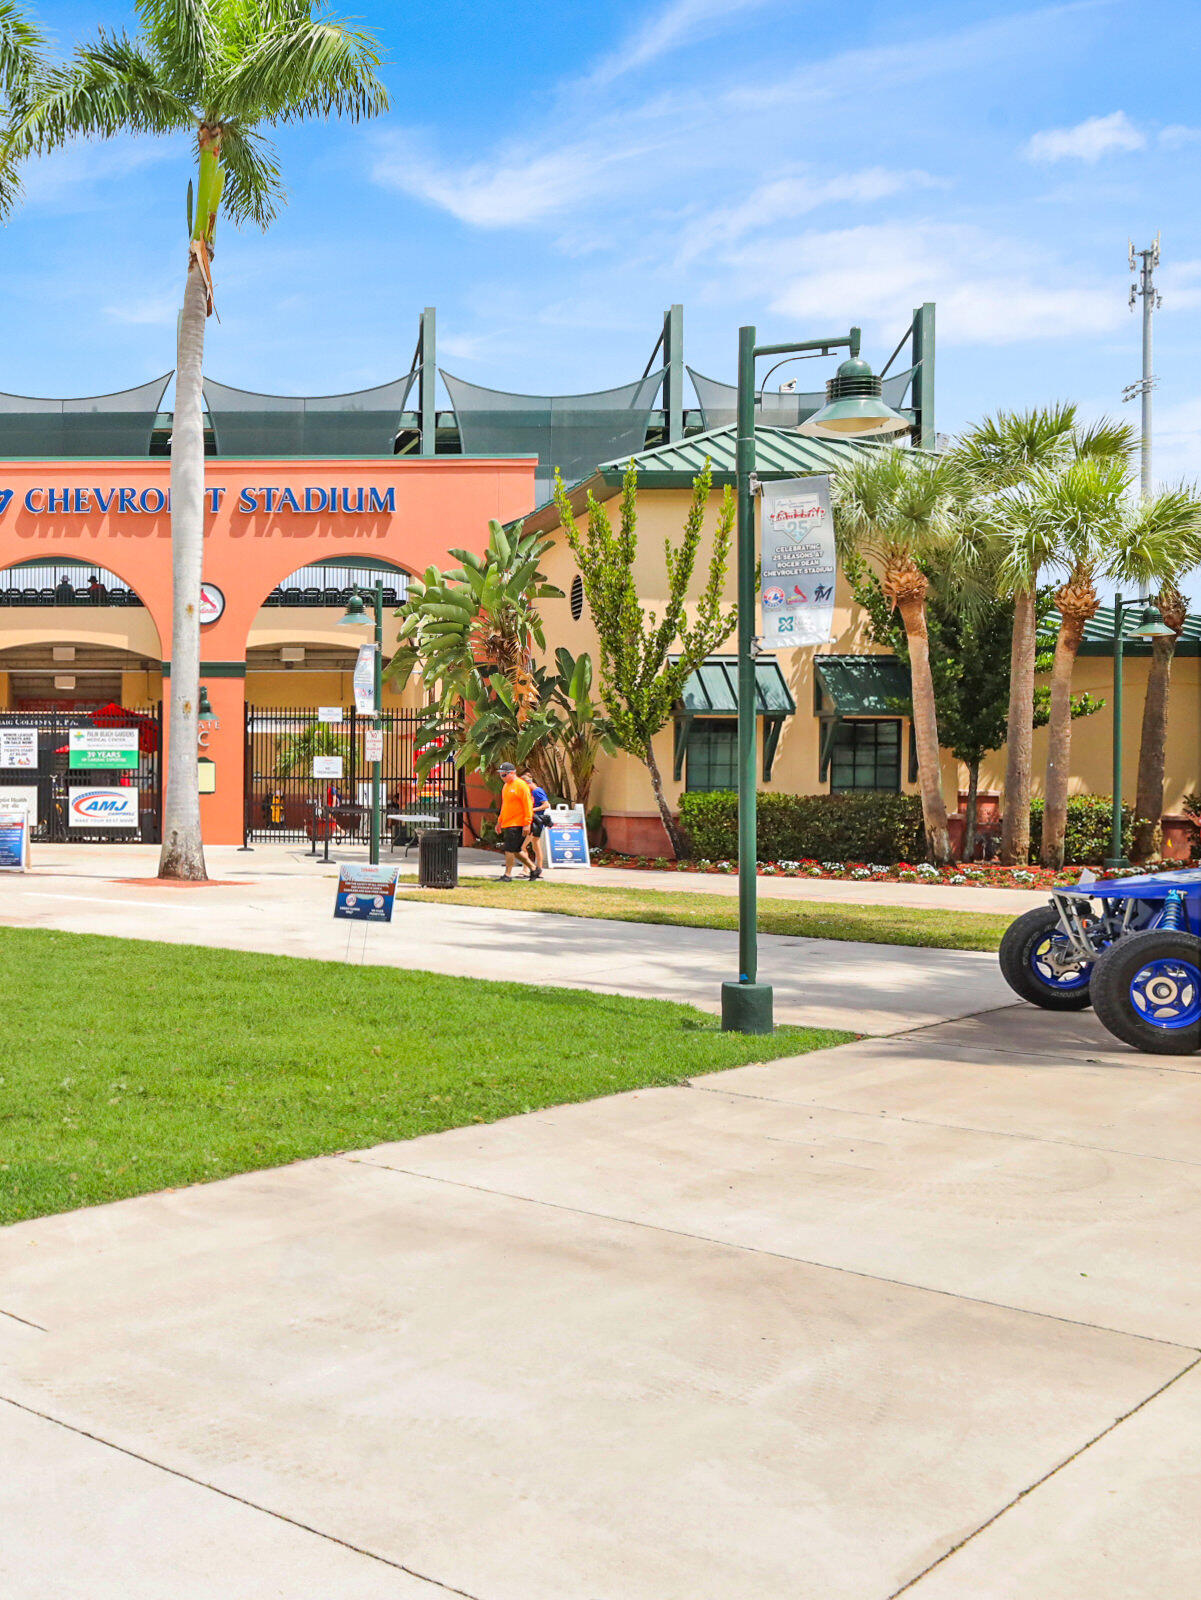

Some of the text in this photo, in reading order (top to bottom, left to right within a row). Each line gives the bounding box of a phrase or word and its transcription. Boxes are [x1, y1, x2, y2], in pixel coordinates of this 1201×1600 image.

[25, 487, 226, 513] CHEVROT
[239, 487, 396, 513] STADIUM
[775, 543, 821, 553] CELEBRATING
[777, 561, 800, 569] ROGER
[763, 566, 834, 578] CHEVROLET STADIUM
[199, 721, 220, 729] ATE
[198, 730, 210, 747] C
[85, 800, 128, 811] AMJ
